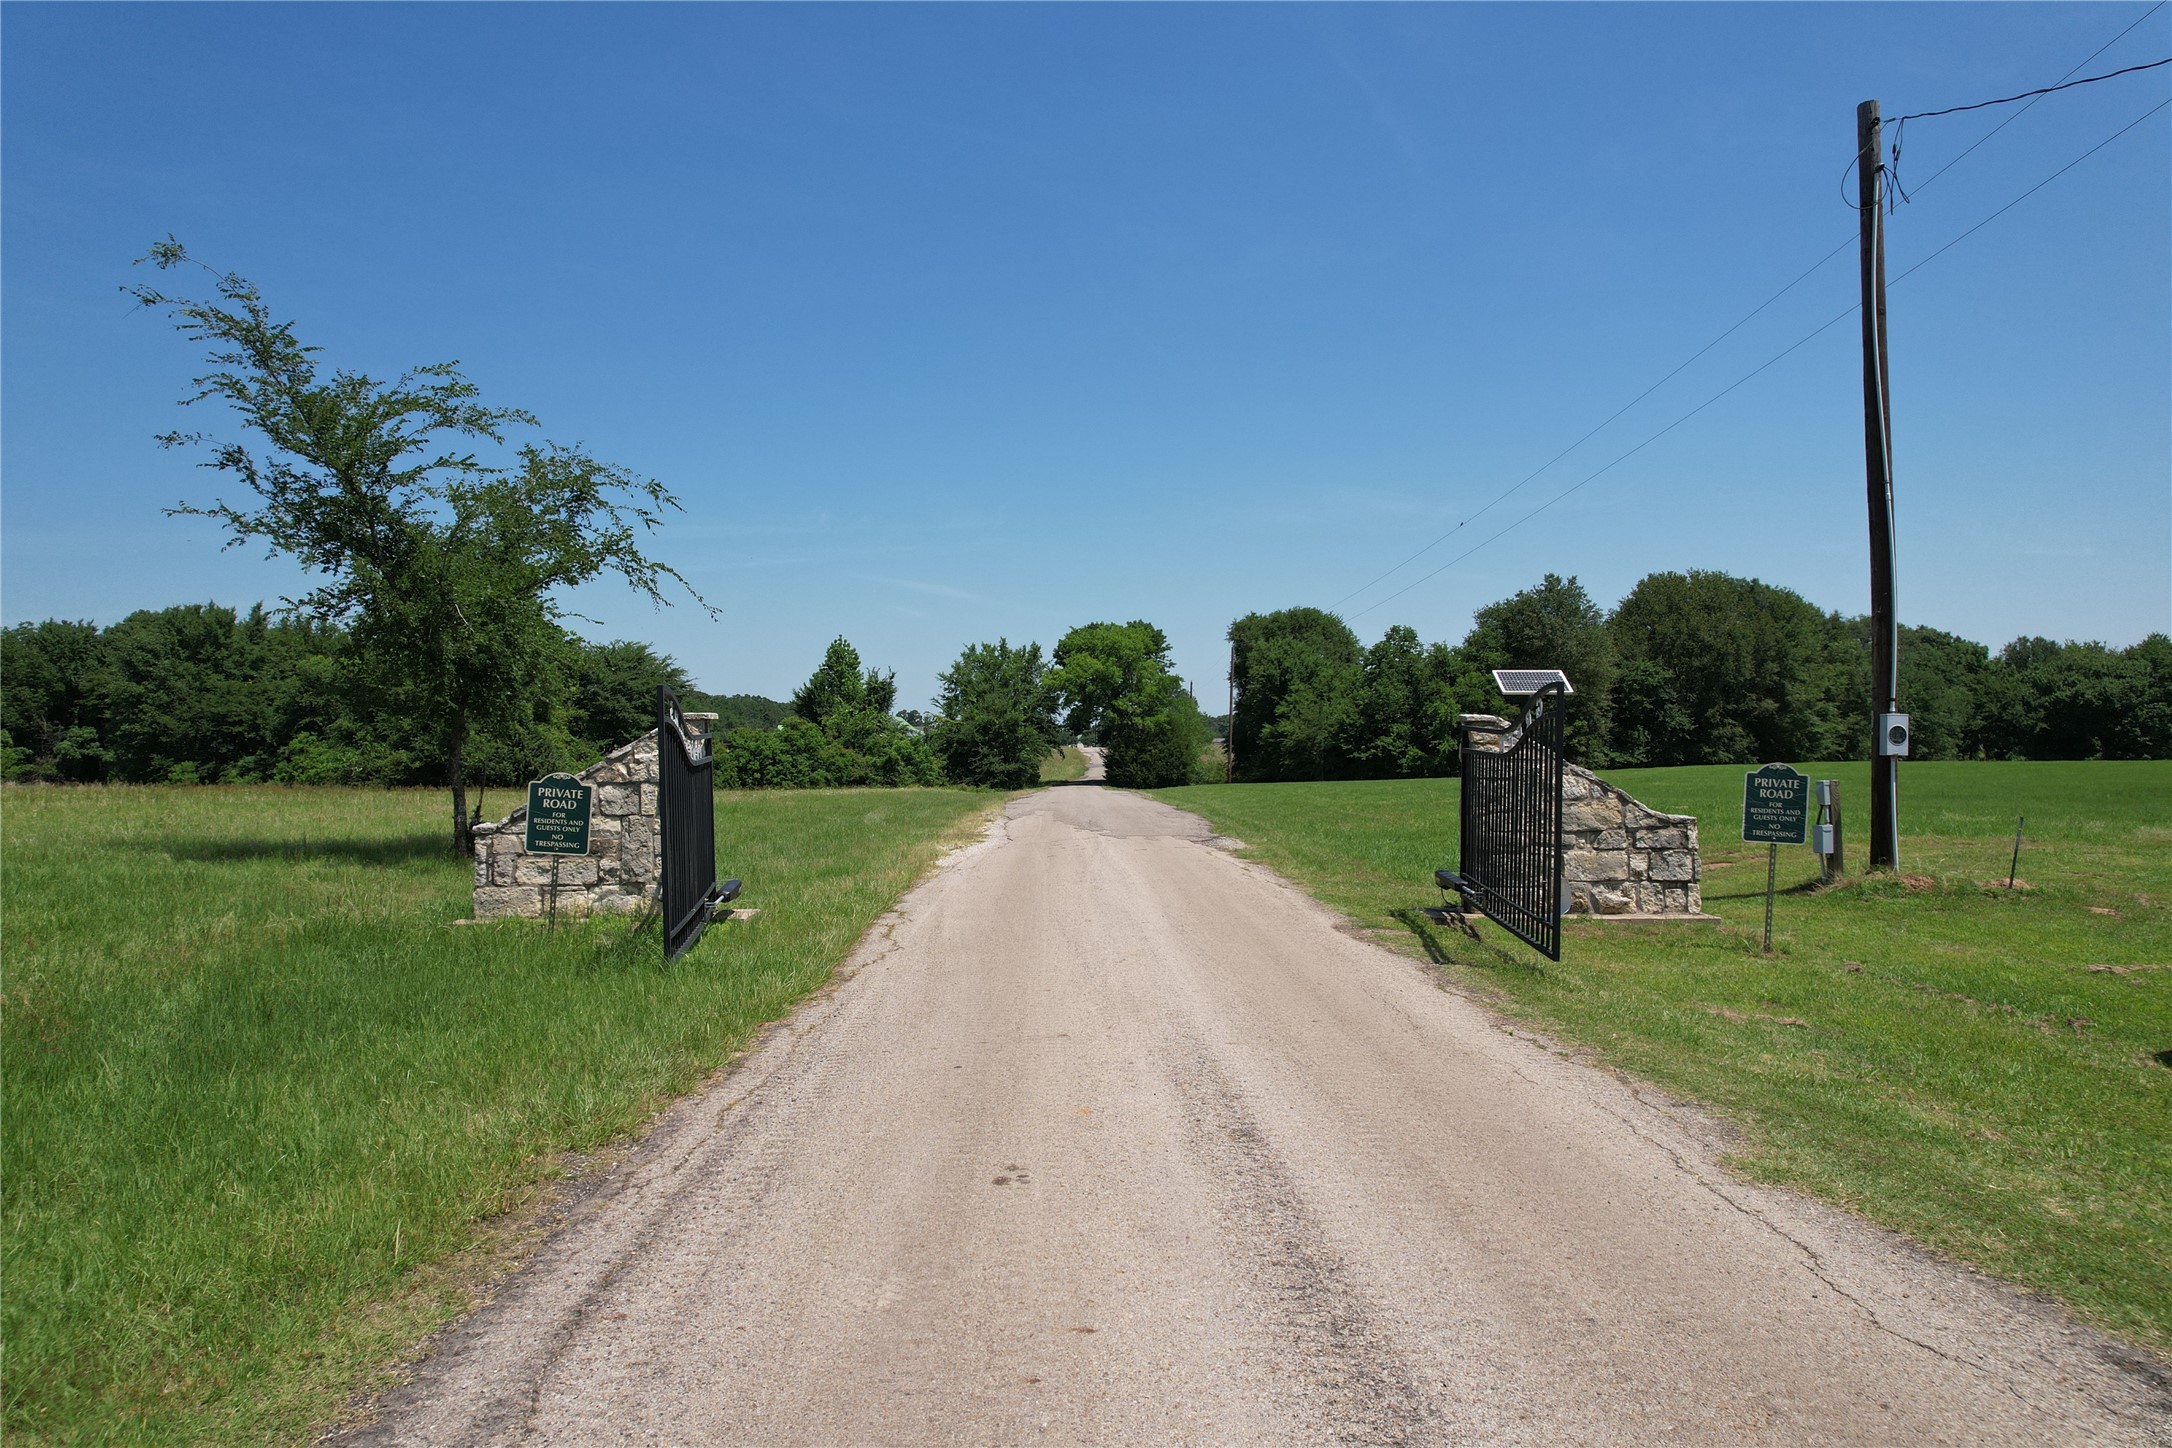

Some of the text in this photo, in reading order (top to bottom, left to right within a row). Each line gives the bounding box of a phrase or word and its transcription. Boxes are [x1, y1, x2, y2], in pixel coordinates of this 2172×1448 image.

[1754, 778, 1800, 789] PRIVATE
[538, 788, 583, 799] PRIVATE
[1760, 789, 1793, 799] ROAD
[543, 799, 576, 809] ROAD
